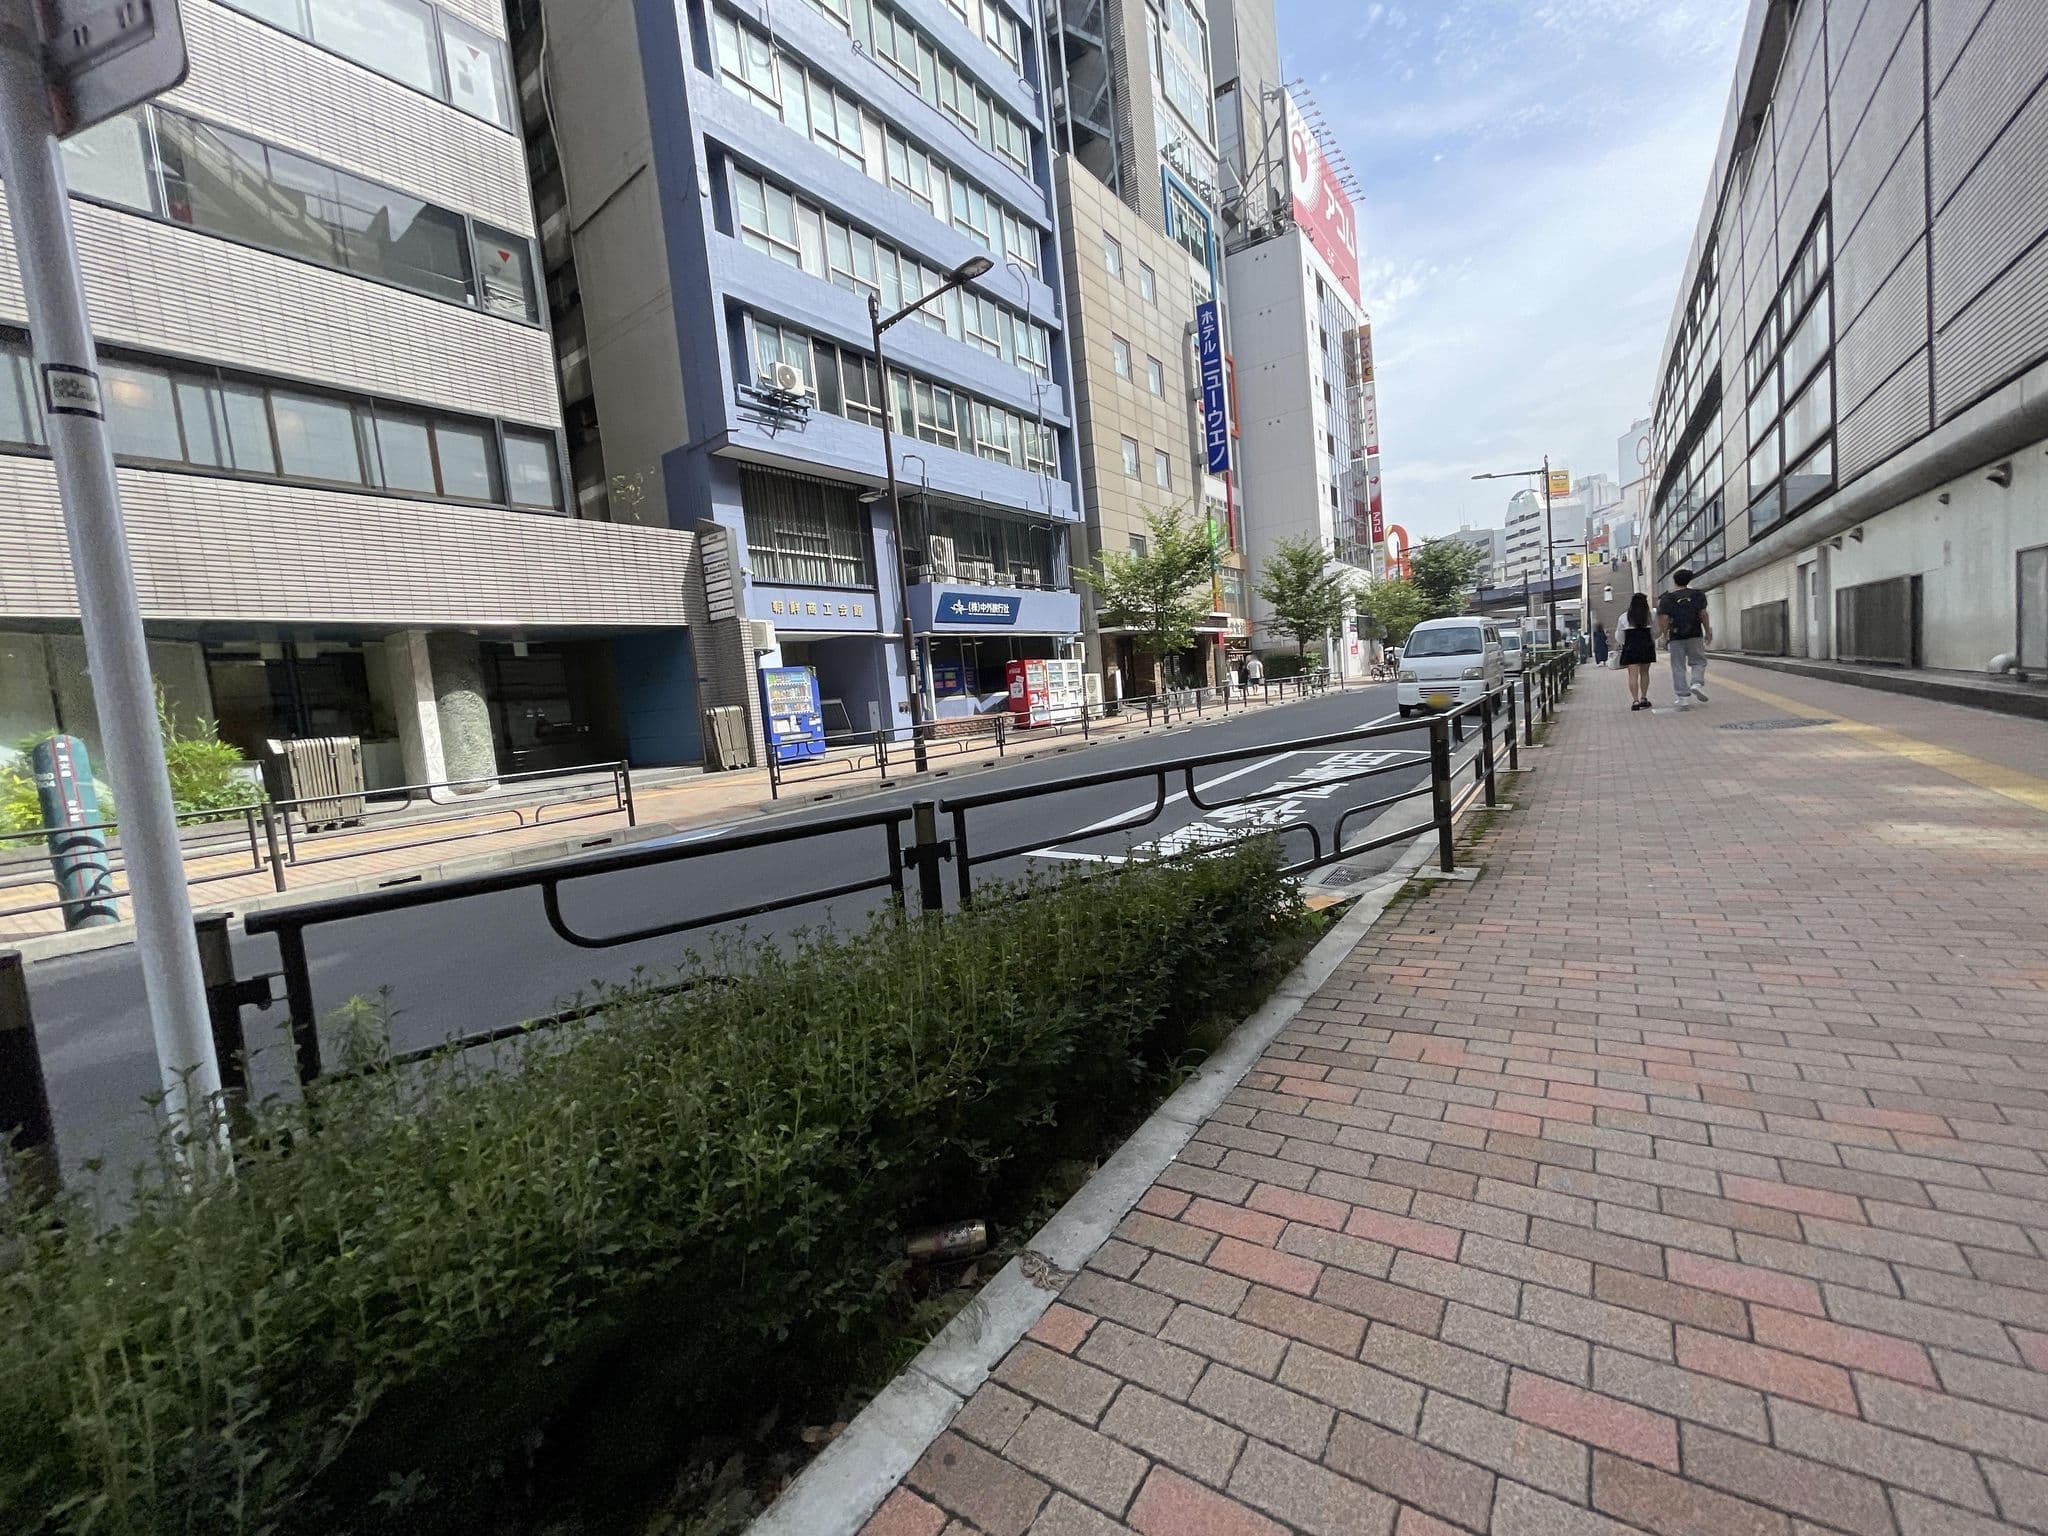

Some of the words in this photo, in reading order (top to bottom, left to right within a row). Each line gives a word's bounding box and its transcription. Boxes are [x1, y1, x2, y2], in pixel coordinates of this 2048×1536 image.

[1201, 310, 1226, 467] ホテルニューウエノ
